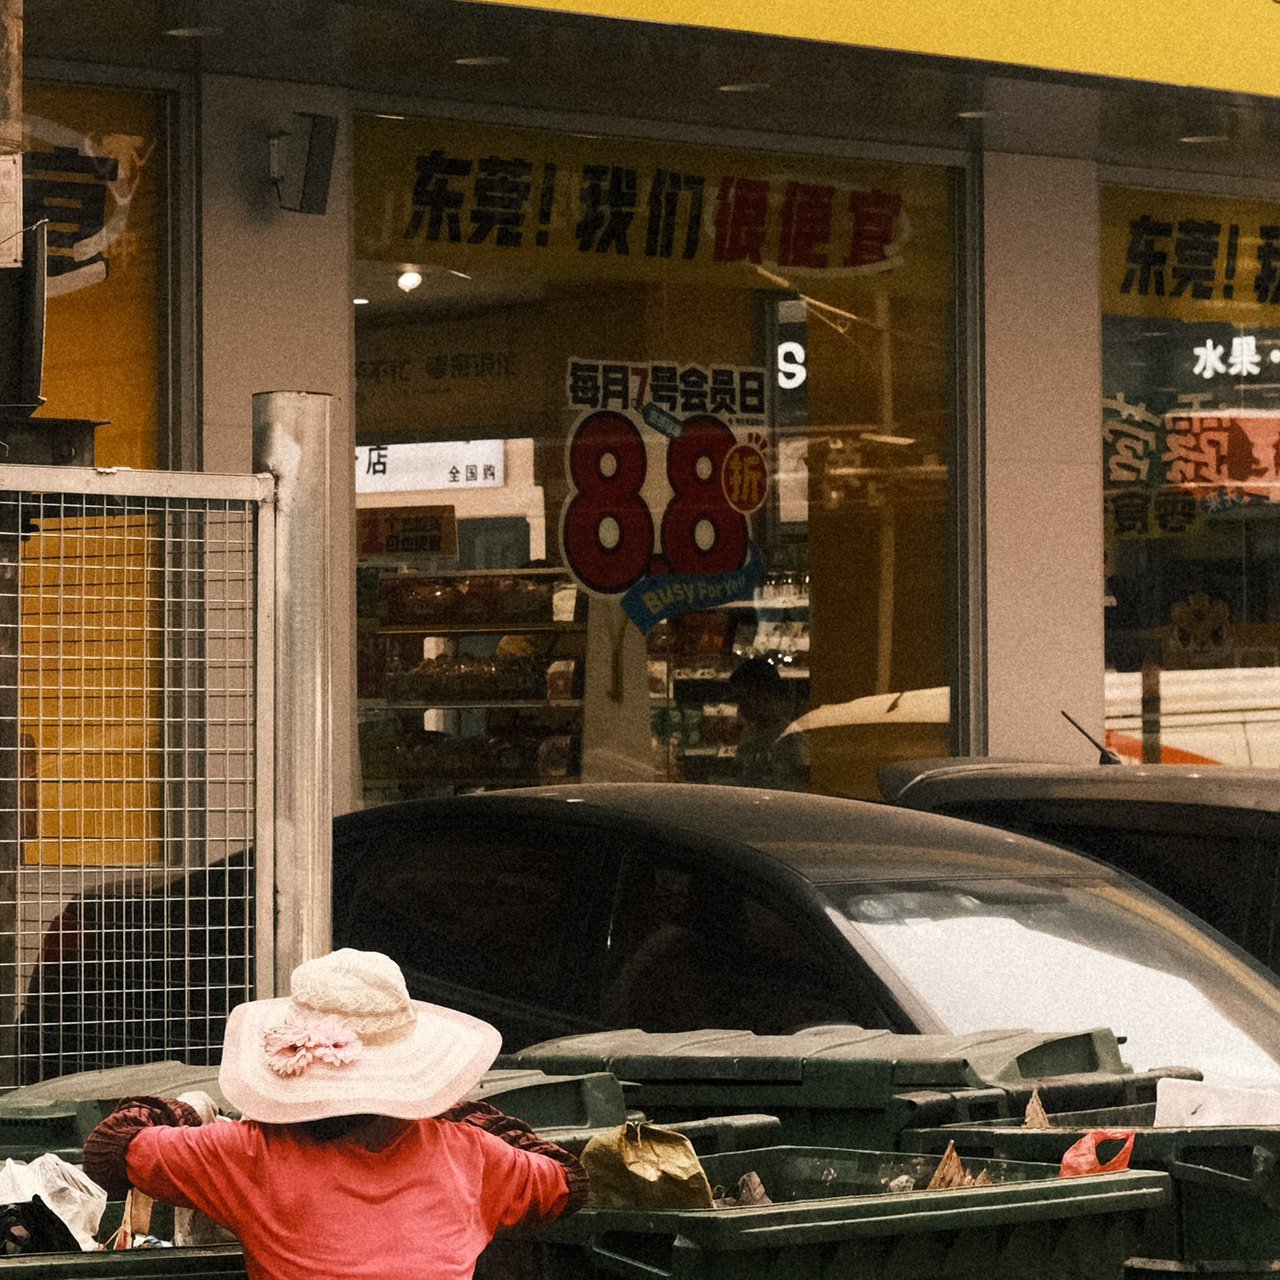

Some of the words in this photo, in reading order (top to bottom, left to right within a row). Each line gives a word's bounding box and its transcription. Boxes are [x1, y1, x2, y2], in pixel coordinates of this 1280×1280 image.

[571, 362, 766, 414] 每月7号会员日
[728, 452, 763, 504] 折
